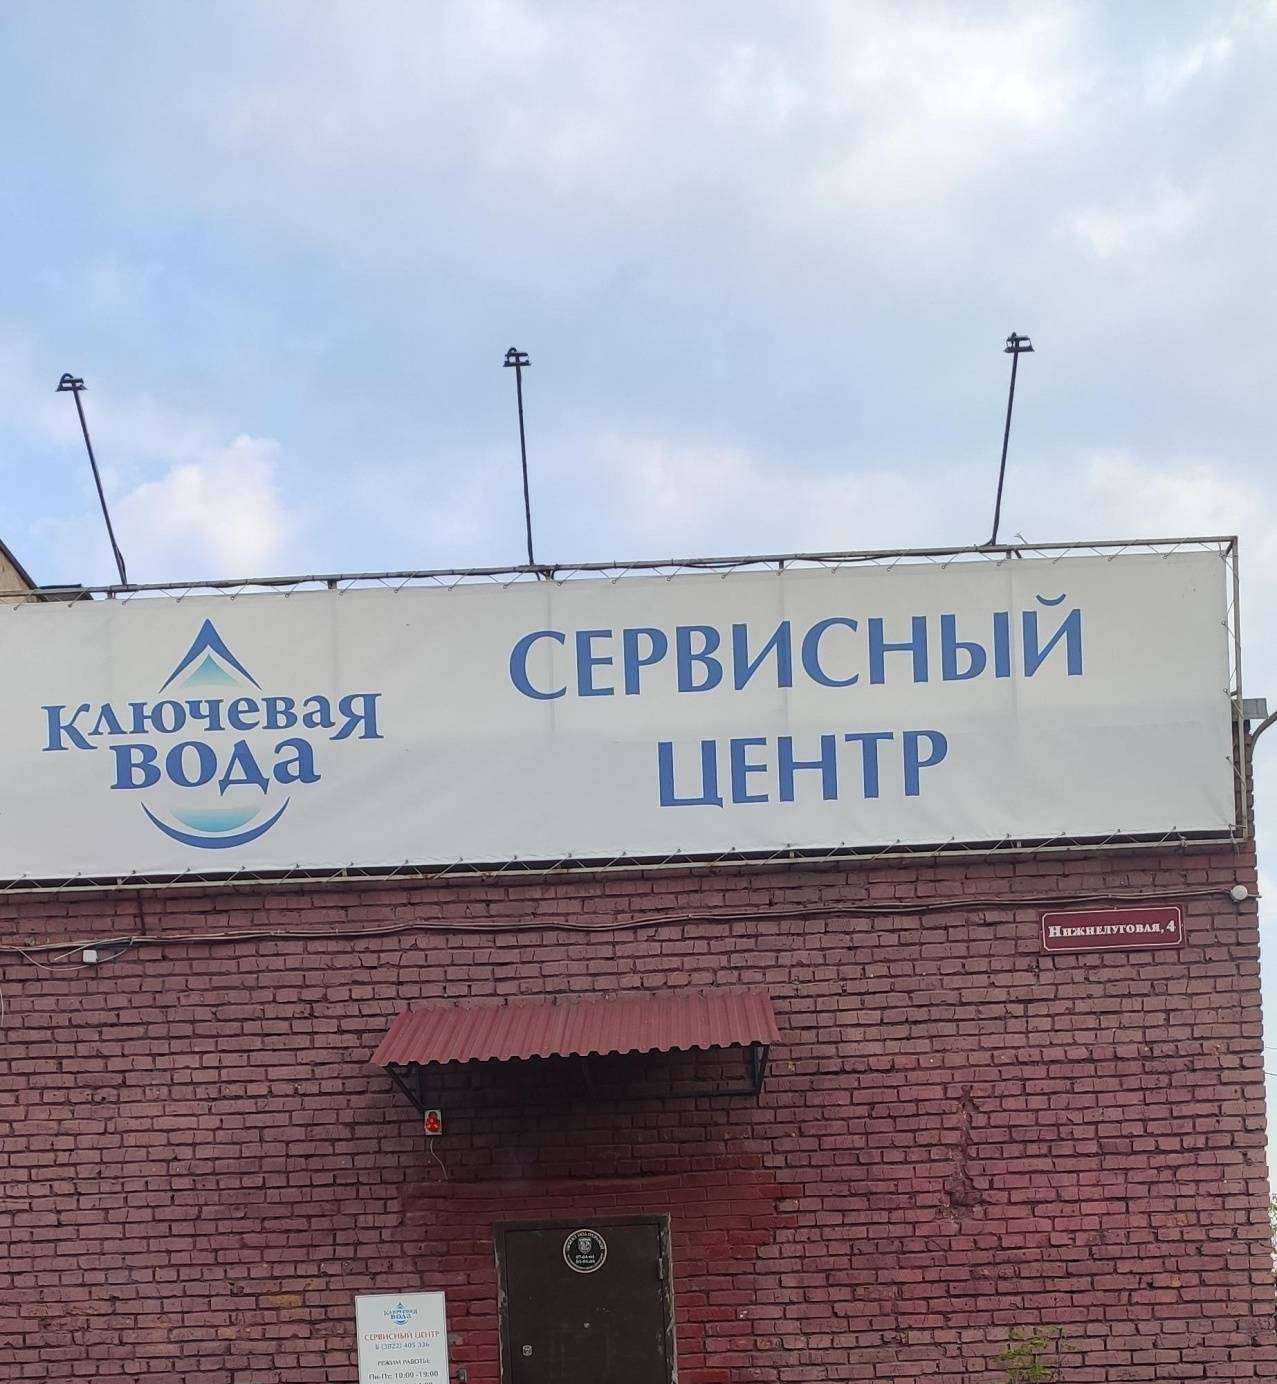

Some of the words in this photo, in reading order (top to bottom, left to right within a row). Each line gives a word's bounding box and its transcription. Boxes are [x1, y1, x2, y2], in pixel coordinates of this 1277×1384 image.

[508, 593, 1085, 700] СЕРВИСНЫЙ
[657, 729, 949, 809] ЦЕНТР
[1166, 920, 1176, 932] 4
[414, 1330, 440, 1339] ЦЕНТР
